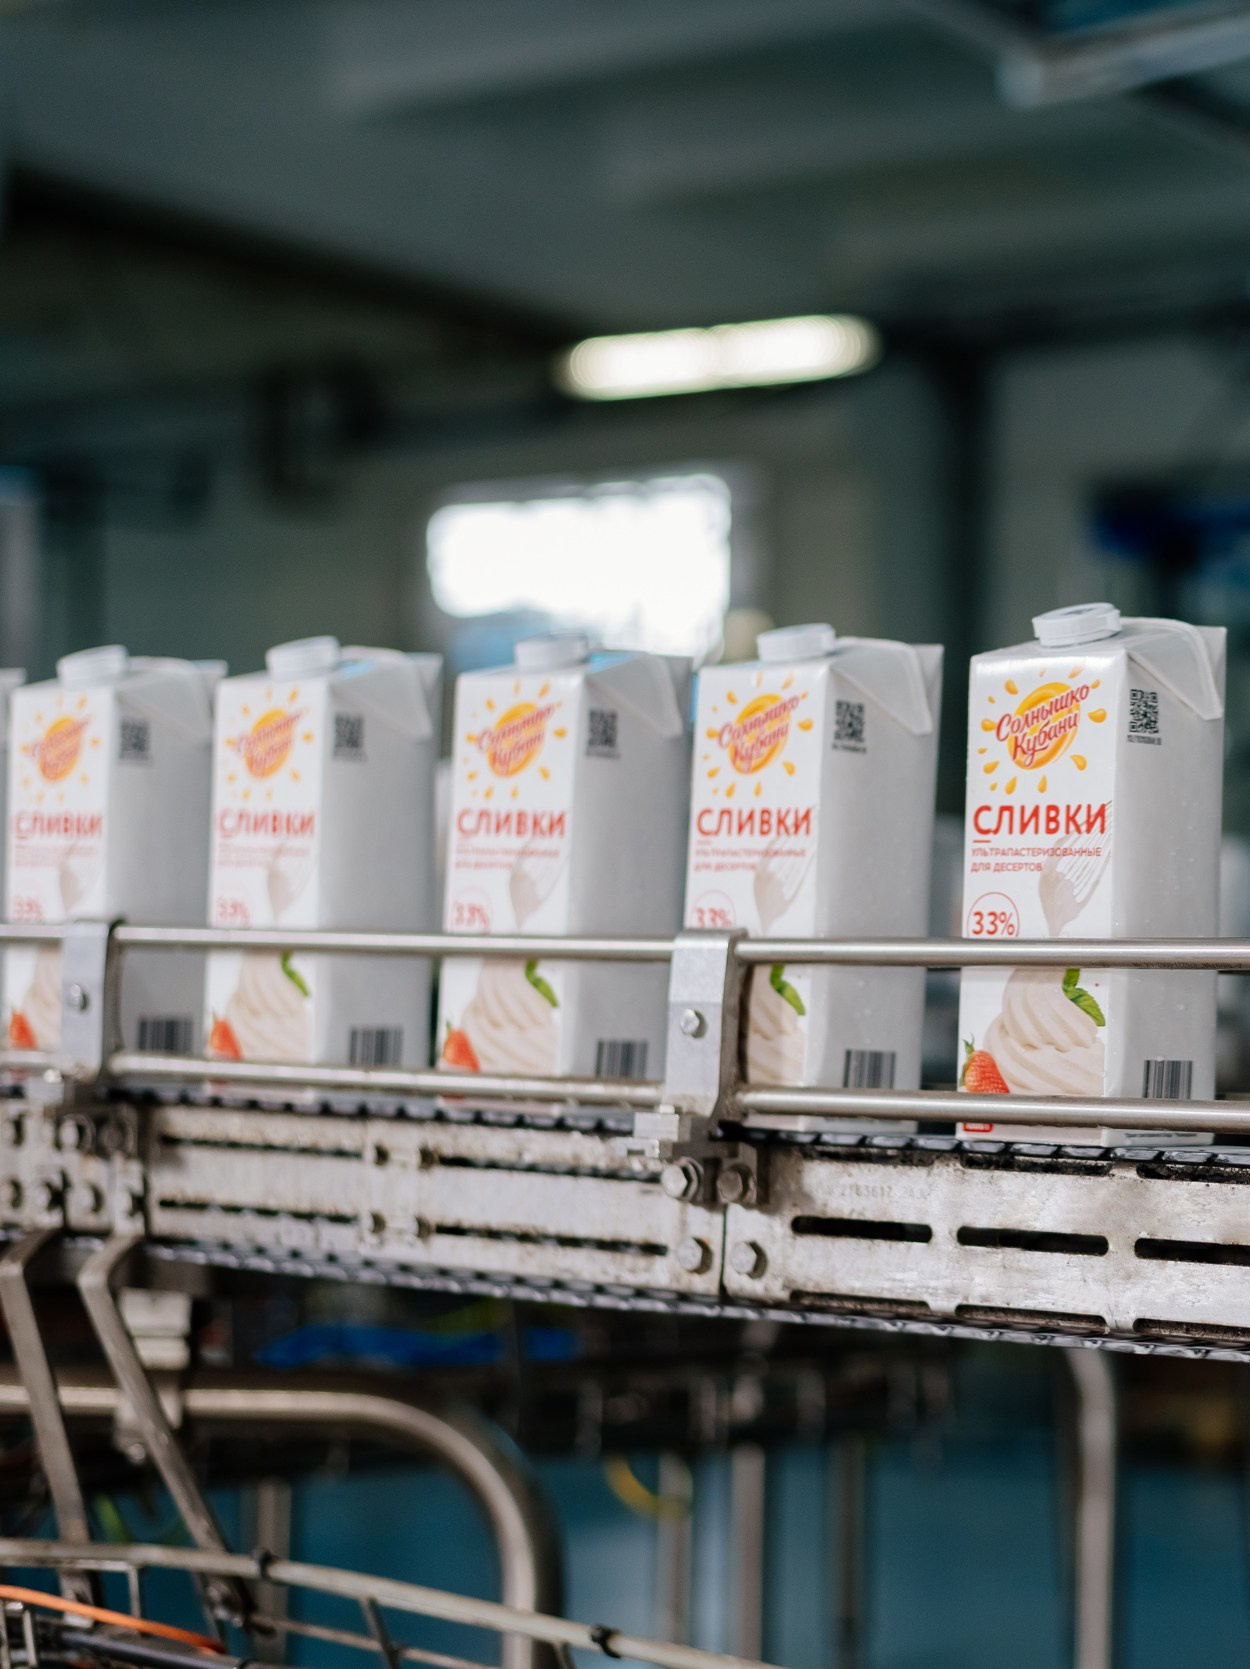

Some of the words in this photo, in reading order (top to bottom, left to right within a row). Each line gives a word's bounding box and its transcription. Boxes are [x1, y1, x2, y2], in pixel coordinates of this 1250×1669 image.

[995, 684, 1090, 742] Солнышко
[1013, 713, 1079, 767] Кубани
[219, 809, 315, 837] СЛИВКИ
[457, 808, 566, 838] СЛИВКИ
[697, 808, 811, 836] СЛИВКИ
[973, 803, 1106, 836] СЛИВКИ
[971, 847, 1102, 858] УЛЬТРАПАСТЕРИЗОВАННЫЕ
[970, 862, 991, 873] ДЛЯ
[993, 861, 1043, 873] ДЕСЕРТОВ
[972, 911, 1015, 936] 33%
